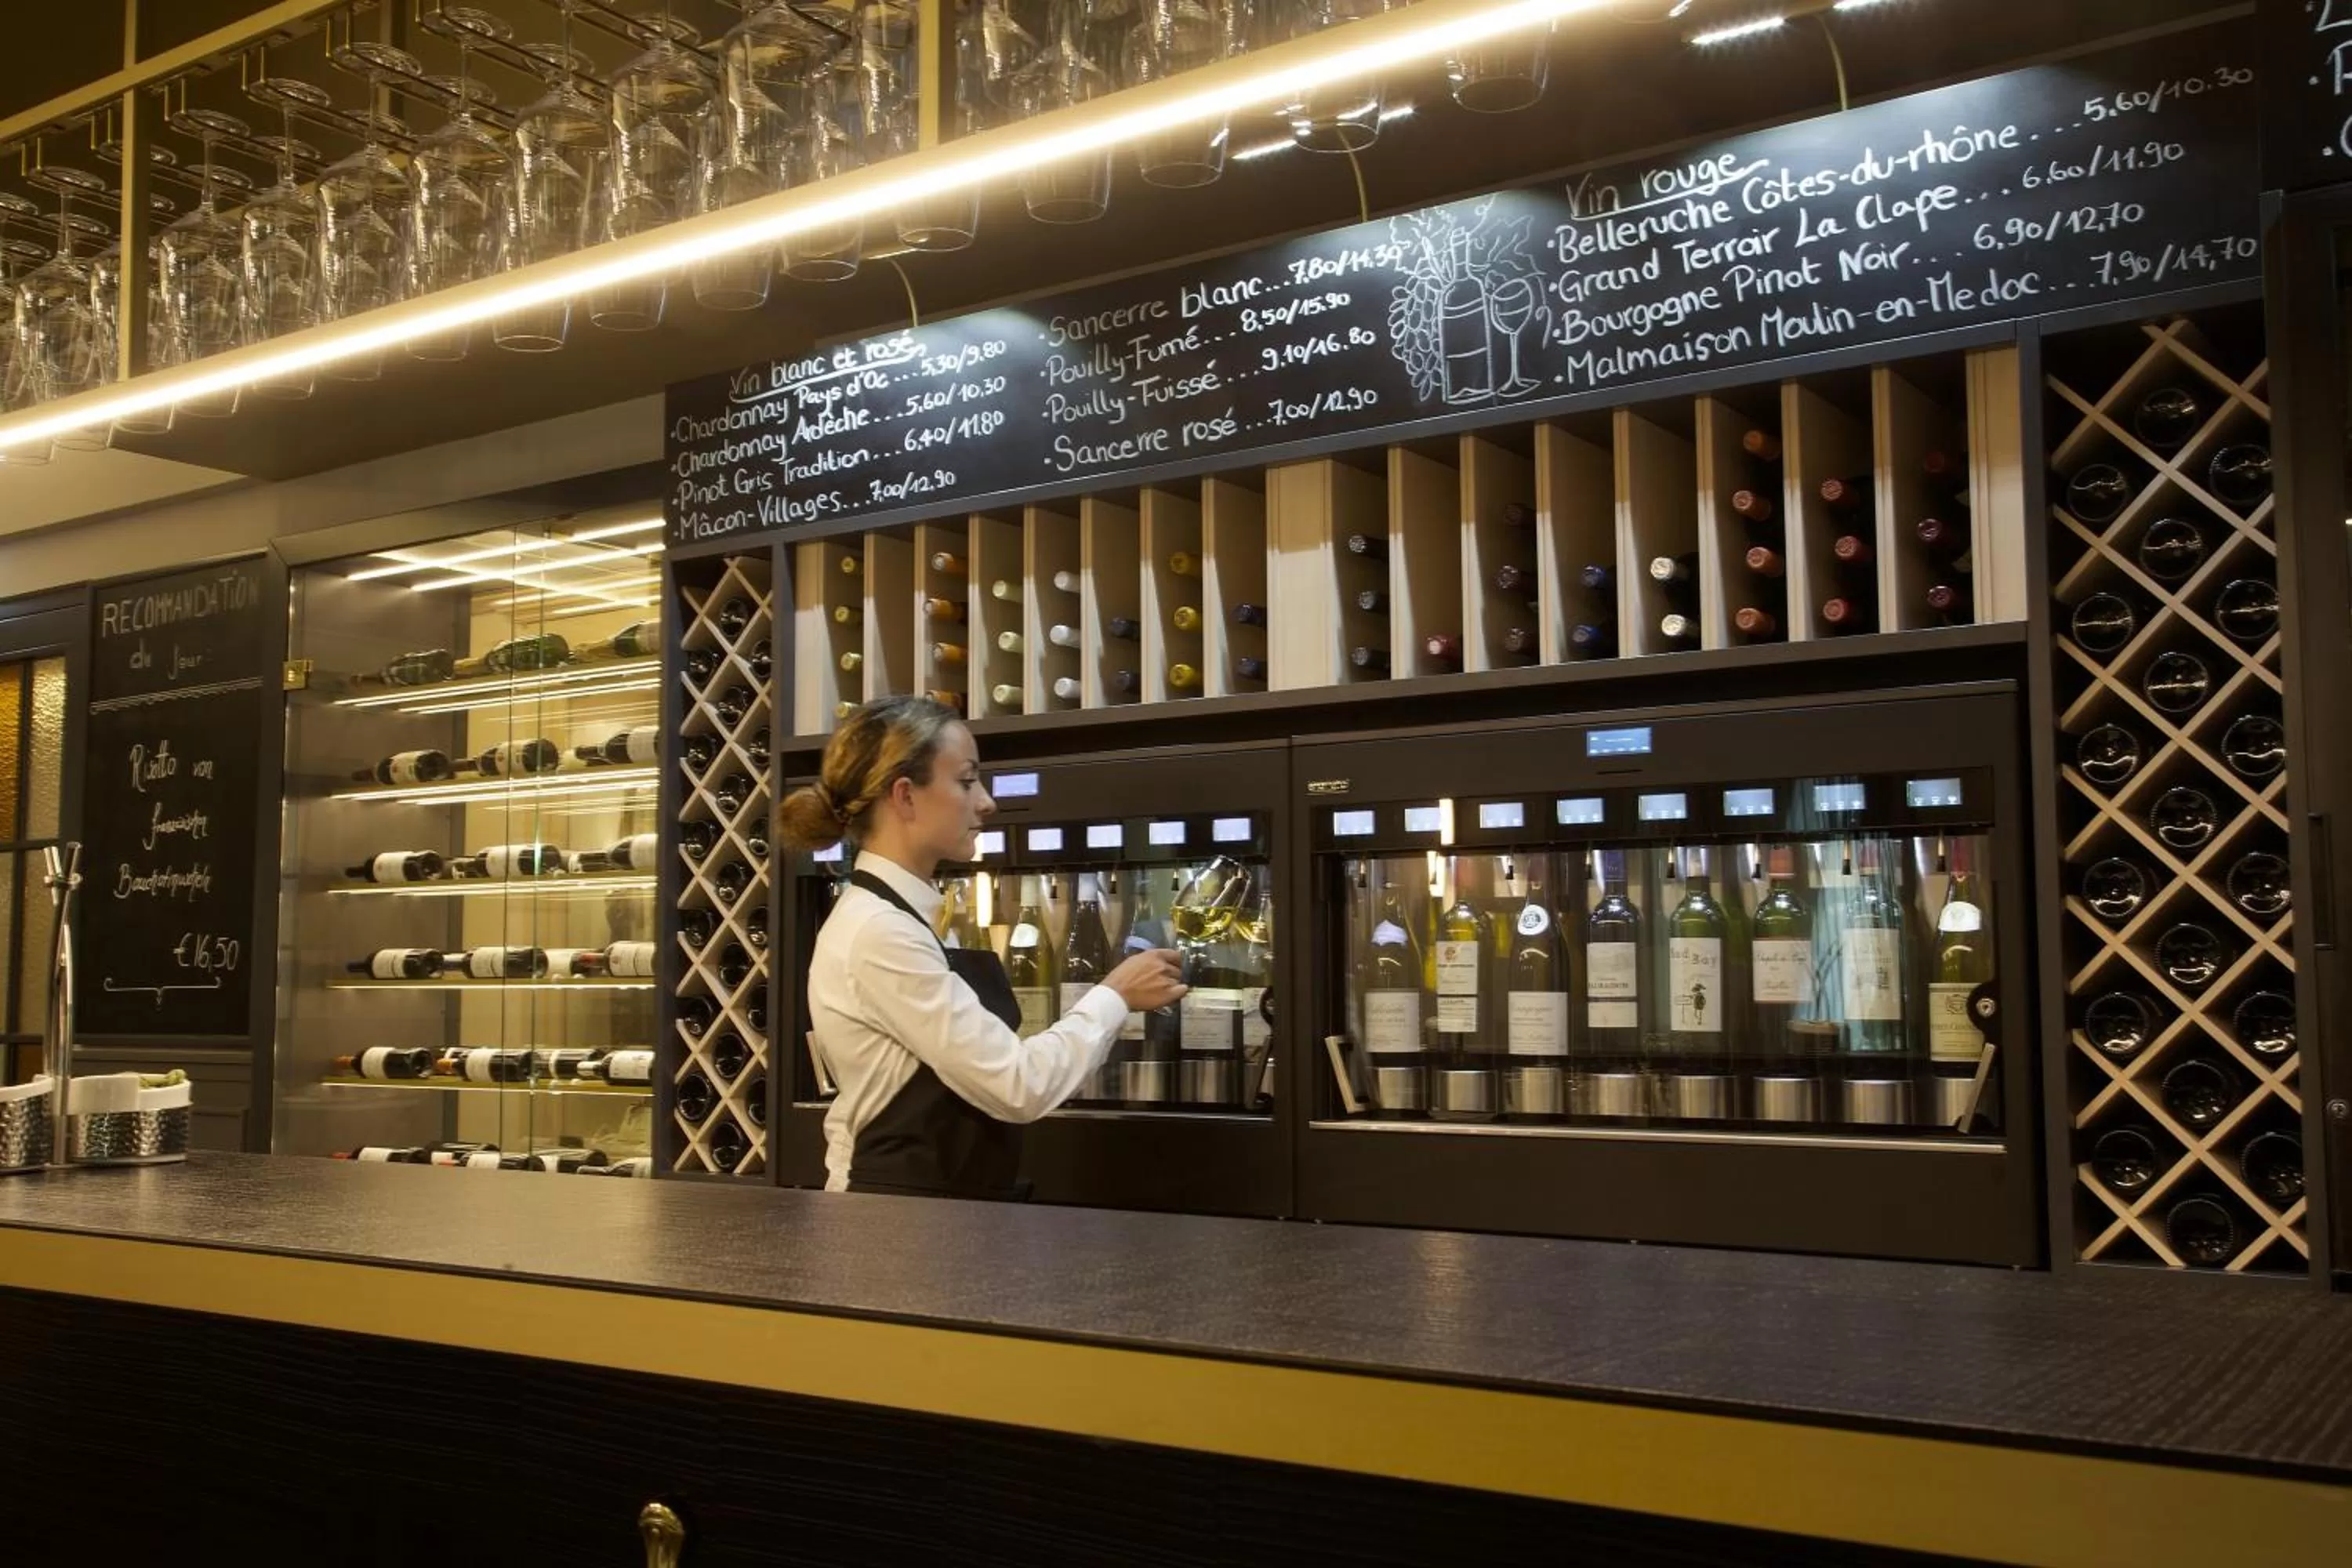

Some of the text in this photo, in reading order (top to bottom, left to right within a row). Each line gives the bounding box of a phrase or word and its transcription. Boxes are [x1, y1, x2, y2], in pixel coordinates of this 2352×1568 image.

[1566, 154, 1737, 216] Vin rouge
[1556, 198, 1733, 263] Belleruche
[1559, 248, 1661, 304] Grand
[1795, 209, 1846, 249] La
[1855, 184, 1958, 232] Clape
[1049, 299, 1170, 347] Sancerre
[1181, 277, 1262, 318] blanc
[1558, 286, 1722, 346] Bourgogne
[1722, 257, 1822, 301] Pinot
[1838, 241, 1910, 282] Noir
[731, 330, 916, 396] Vin blanc et rosé
[1046, 325, 1202, 386] Pouilly-Fumé
[1567, 324, 1751, 386] Malmaison
[675, 397, 789, 443] Chardonnay
[797, 383, 843, 416] Pays
[1047, 360, 1221, 424] Pouilly-Fuissé
[677, 432, 786, 478] Chardonnay
[792, 407, 870, 445] Ardèche
[1054, 428, 1171, 471] Sancerre
[1182, 407, 1238, 447] rosé
[677, 474, 727, 510] Pinot
[734, 469, 772, 495] Gris
[779, 448, 870, 486] Tradition
[680, 491, 841, 539] Mâcon-Villages
[129, 637, 151, 669] du
